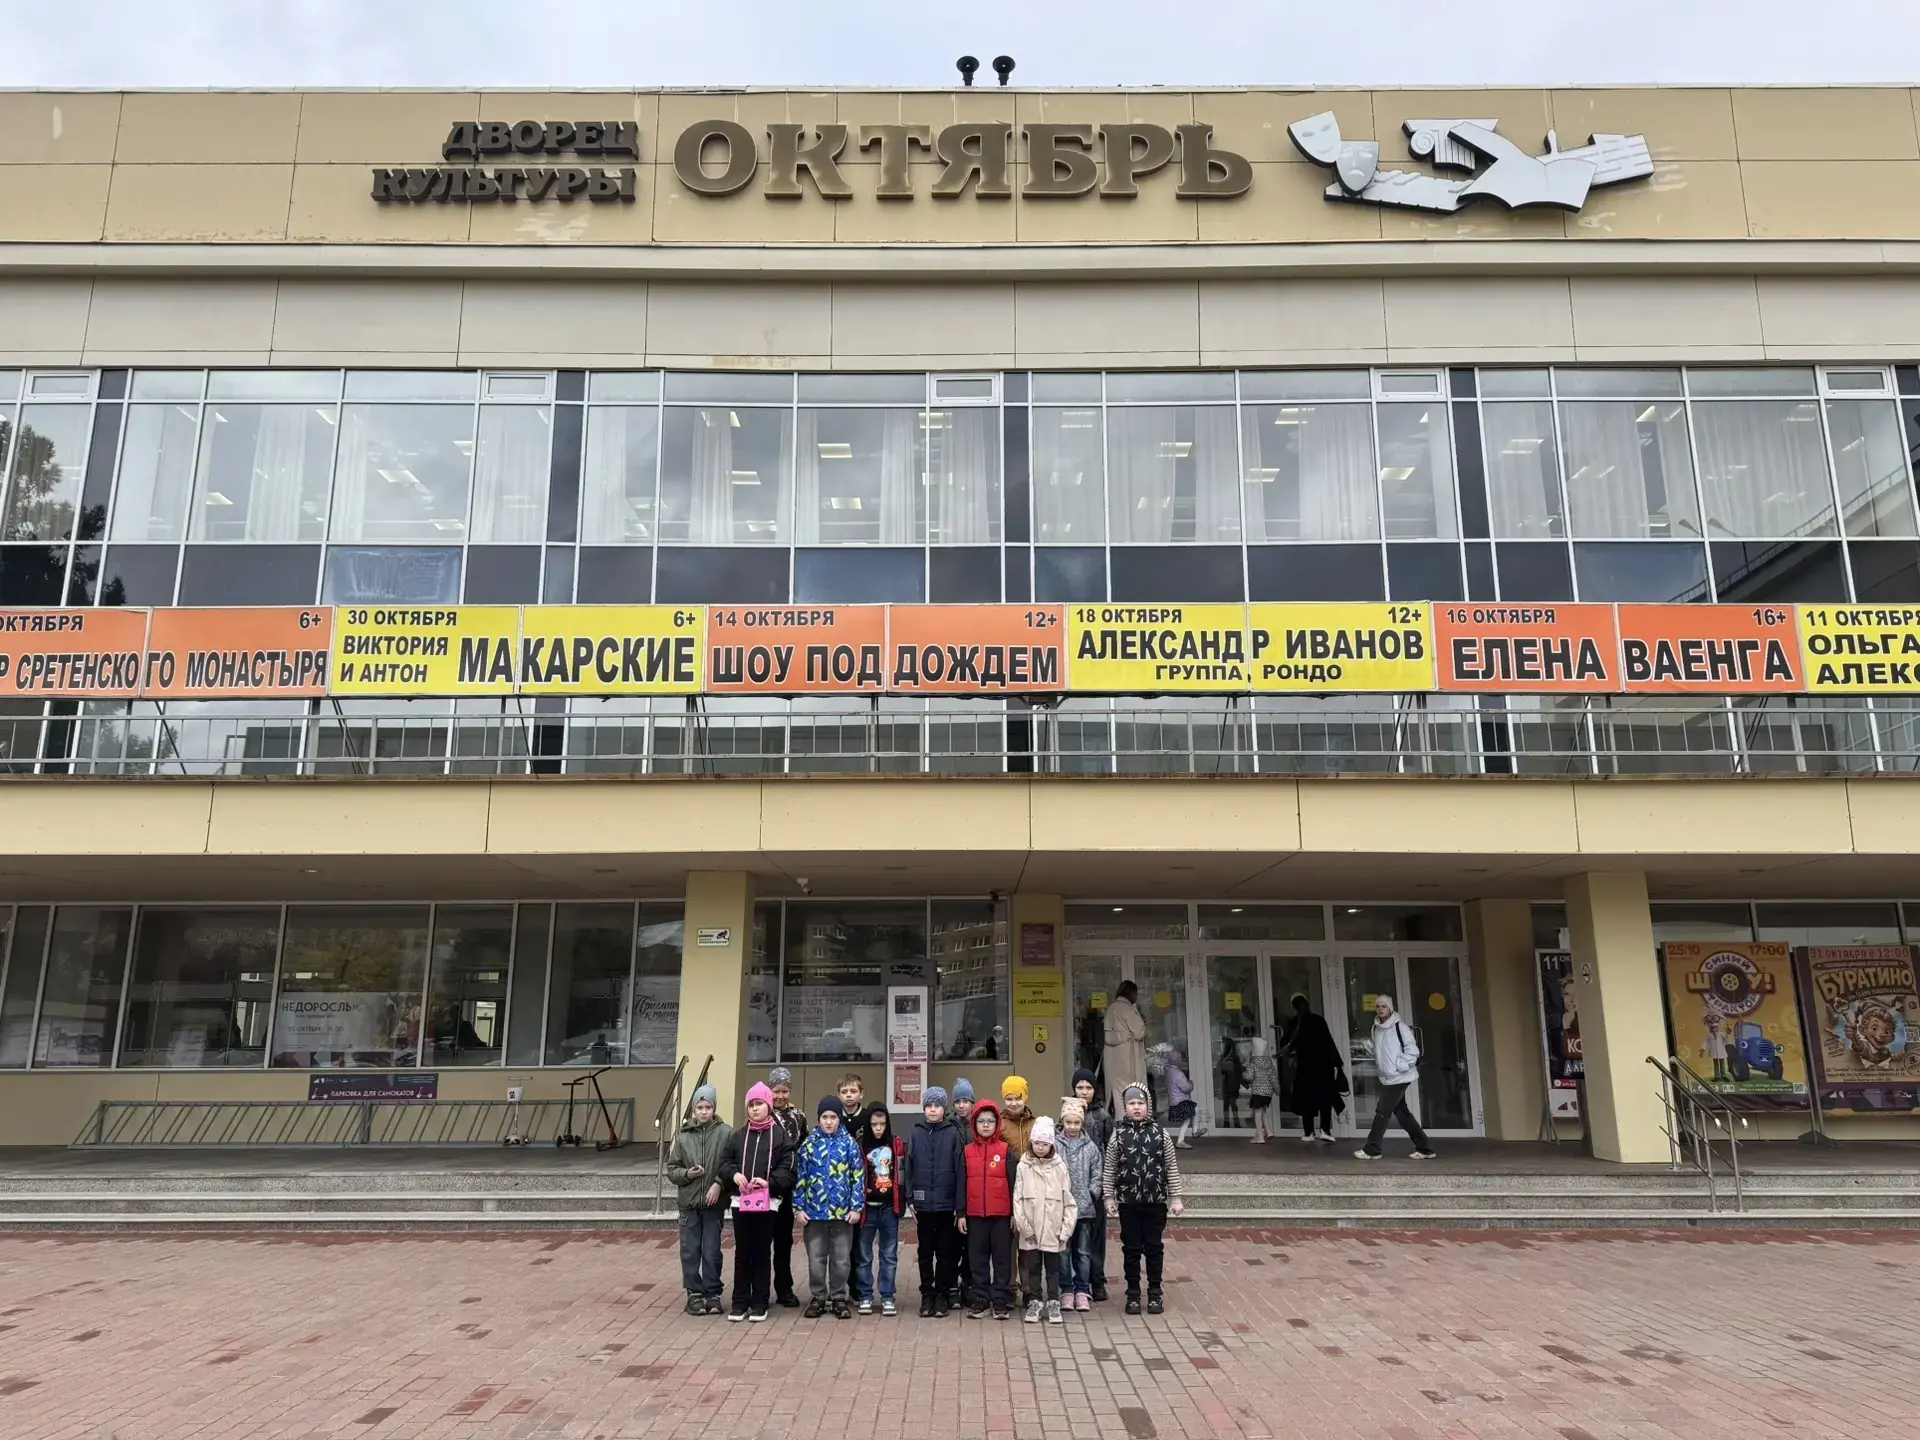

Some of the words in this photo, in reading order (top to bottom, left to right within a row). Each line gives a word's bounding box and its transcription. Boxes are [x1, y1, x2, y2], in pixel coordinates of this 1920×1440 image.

[443, 121, 639, 160] ДВОРЕЦ
[672, 120, 1254, 200] ОКТЯБРЬ
[371, 168, 637, 201] КУЛЬТУРЫ
[299, 611, 321, 629] 6+
[347, 610, 368, 625] 30
[374, 610, 457, 626] ОКТЯБРЯ
[673, 610, 696, 627] 6+
[715, 611, 737, 627] 14
[743, 610, 835, 626] ОКТЯБРЯ
[1024, 611, 1057, 628] 12+
[1077, 608, 1096, 623] 18
[1101, 608, 1182, 623] ОКТЯБРЯ
[1388, 607, 1422, 623] 12+
[1446, 608, 1468, 623] 16
[1473, 608, 1555, 624] ОКТЯБРЯ
[1752, 608, 1786, 626] 16+
[1806, 610, 1828, 626] 11
[343, 635, 449, 656] ВИКТОРИЯ
[1286, 629, 1424, 660] ИВАНОВ
[1808, 633, 1920, 655] ОЛЬГА
[712, 646, 794, 684] ШОУ
[806, 645, 883, 687] ПОД
[893, 645, 1059, 688] ДОЖДЕМ
[1451, 637, 1607, 681] ЕЛЕНА
[1622, 639, 1795, 682] ВАЕНГА
[185, 650, 328, 688] МОНАСТЫРЯ
[340, 663, 354, 683] И
[359, 663, 428, 683] АНТОН
[1155, 664, 1243, 681] ГРУППА
[1262, 664, 1342, 683] РОНДО
[1747, 945, 1785, 956] 17:00
[1878, 948, 1909, 958] 12:00
[1543, 955, 1559, 970] 11
[1704, 954, 1751, 971] СИНИЙ
[1815, 967, 1914, 1003] БУРАТИНО
[1708, 992, 1758, 1012] ТРАКТОР
[377, 1089, 415, 1097] САМОКАТОВ
